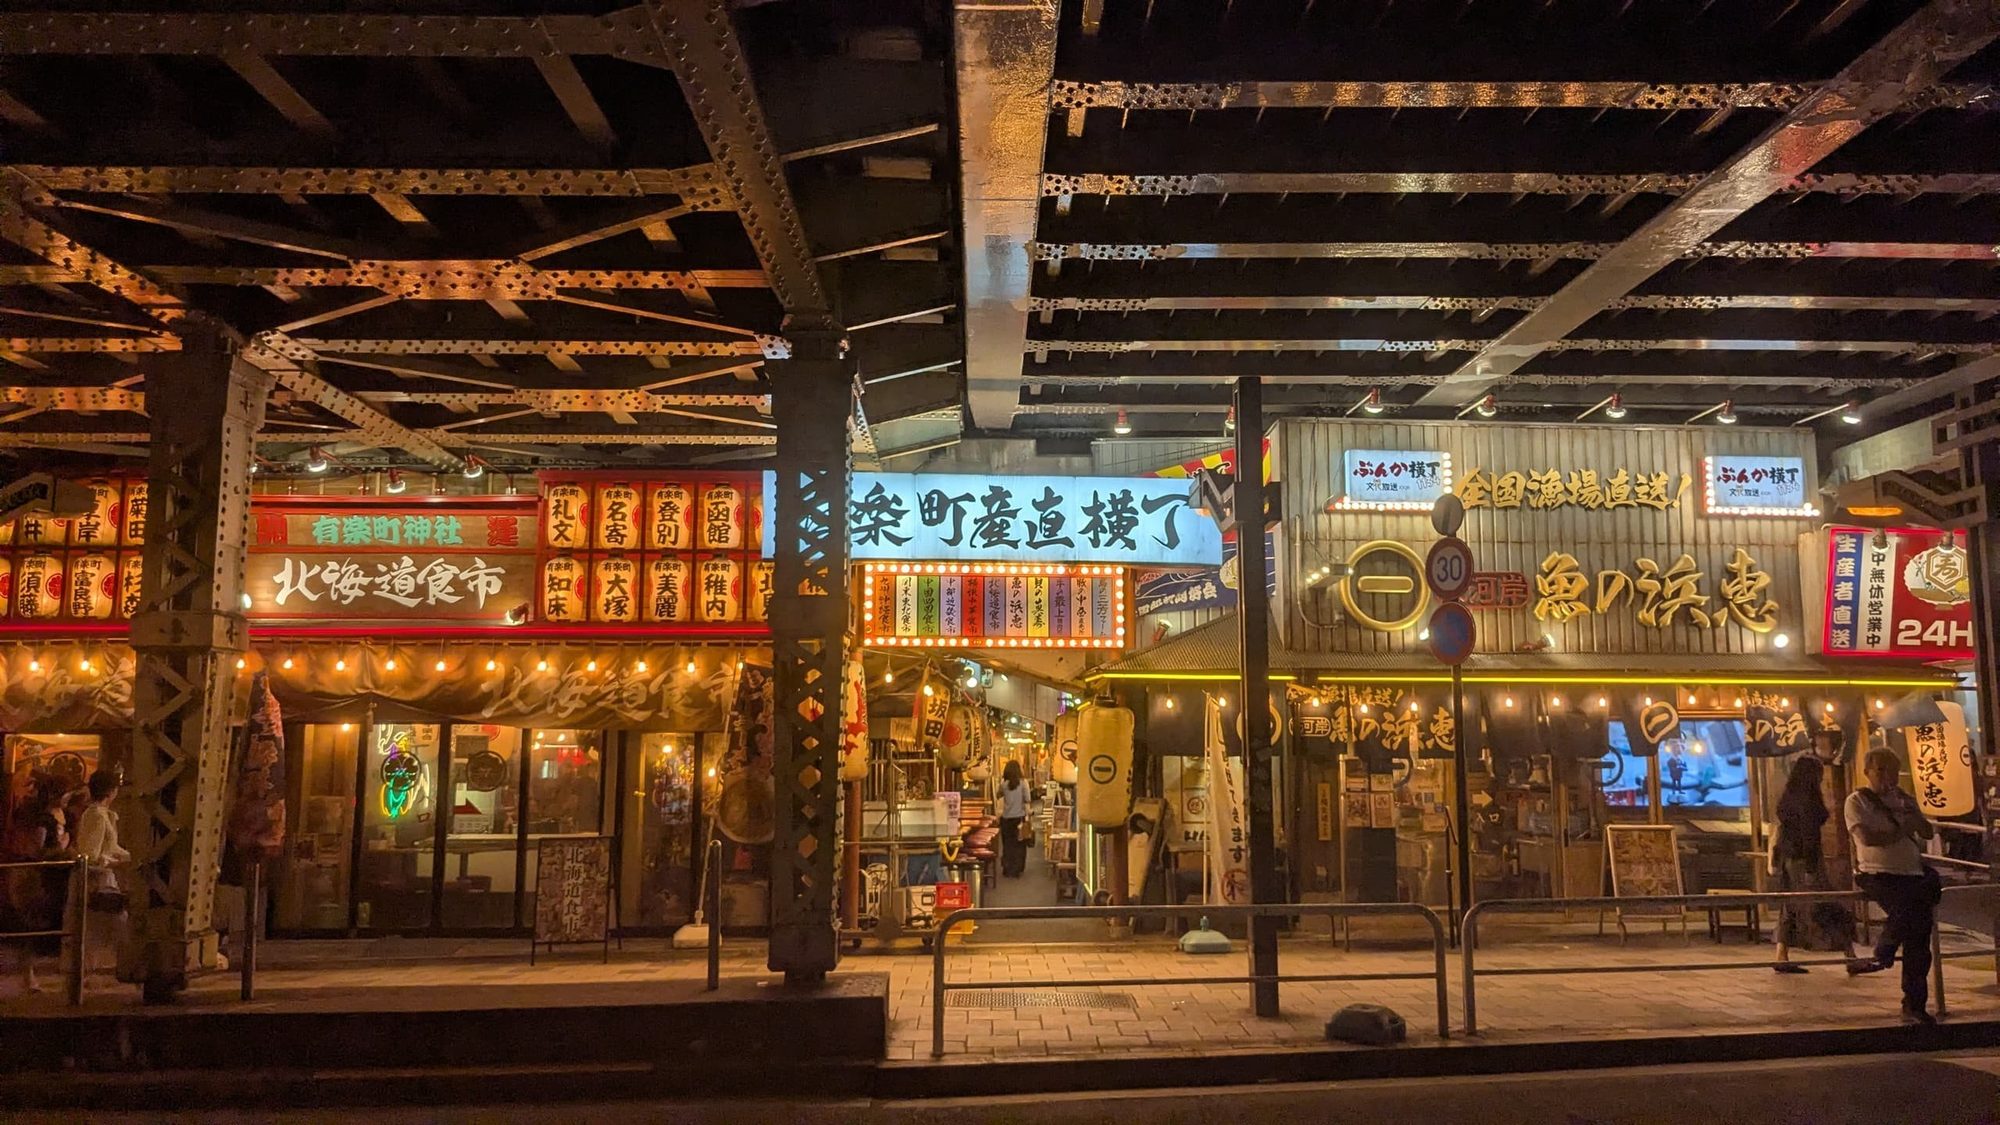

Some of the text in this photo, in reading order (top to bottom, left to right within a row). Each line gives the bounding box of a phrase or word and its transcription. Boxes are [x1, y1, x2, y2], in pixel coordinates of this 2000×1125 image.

[1353, 460, 1440, 478] ぶんか横丁
[1717, 466, 1799, 484] ぶんか横丁
[605, 489, 633, 500] 有楽町
[657, 489, 683, 500] 有楽町
[707, 489, 734, 500] 有楽町
[312, 515, 463, 545] 有楽町神社
[552, 498, 576, 543] 礼文
[605, 500, 628, 545] 名寄
[656, 500, 681, 546] 登別
[706, 501, 732, 545] 函館
[852, 482, 1193, 551] 楽町産直横丁
[273, 556, 505, 609] 北海道食市
[602, 562, 631, 573] 有楽町
[654, 562, 682, 573] 有楽町
[703, 562, 731, 573] 有楽町
[1436, 555, 1462, 582] 30
[72, 570, 96, 617] 富良野
[547, 573, 573, 617] 知床
[603, 573, 631, 617] 大塚
[704, 573, 728, 618] 稚内
[1468, 574, 1529, 606] 河岸
[1532, 548, 1779, 632] 魚の浜恵
[1831, 534, 1857, 649] 生産者直送
[1866, 553, 1886, 648] 中無休営業中
[1897, 619, 1973, 647] 24H
[1475, 813, 1500, 824] 入口
